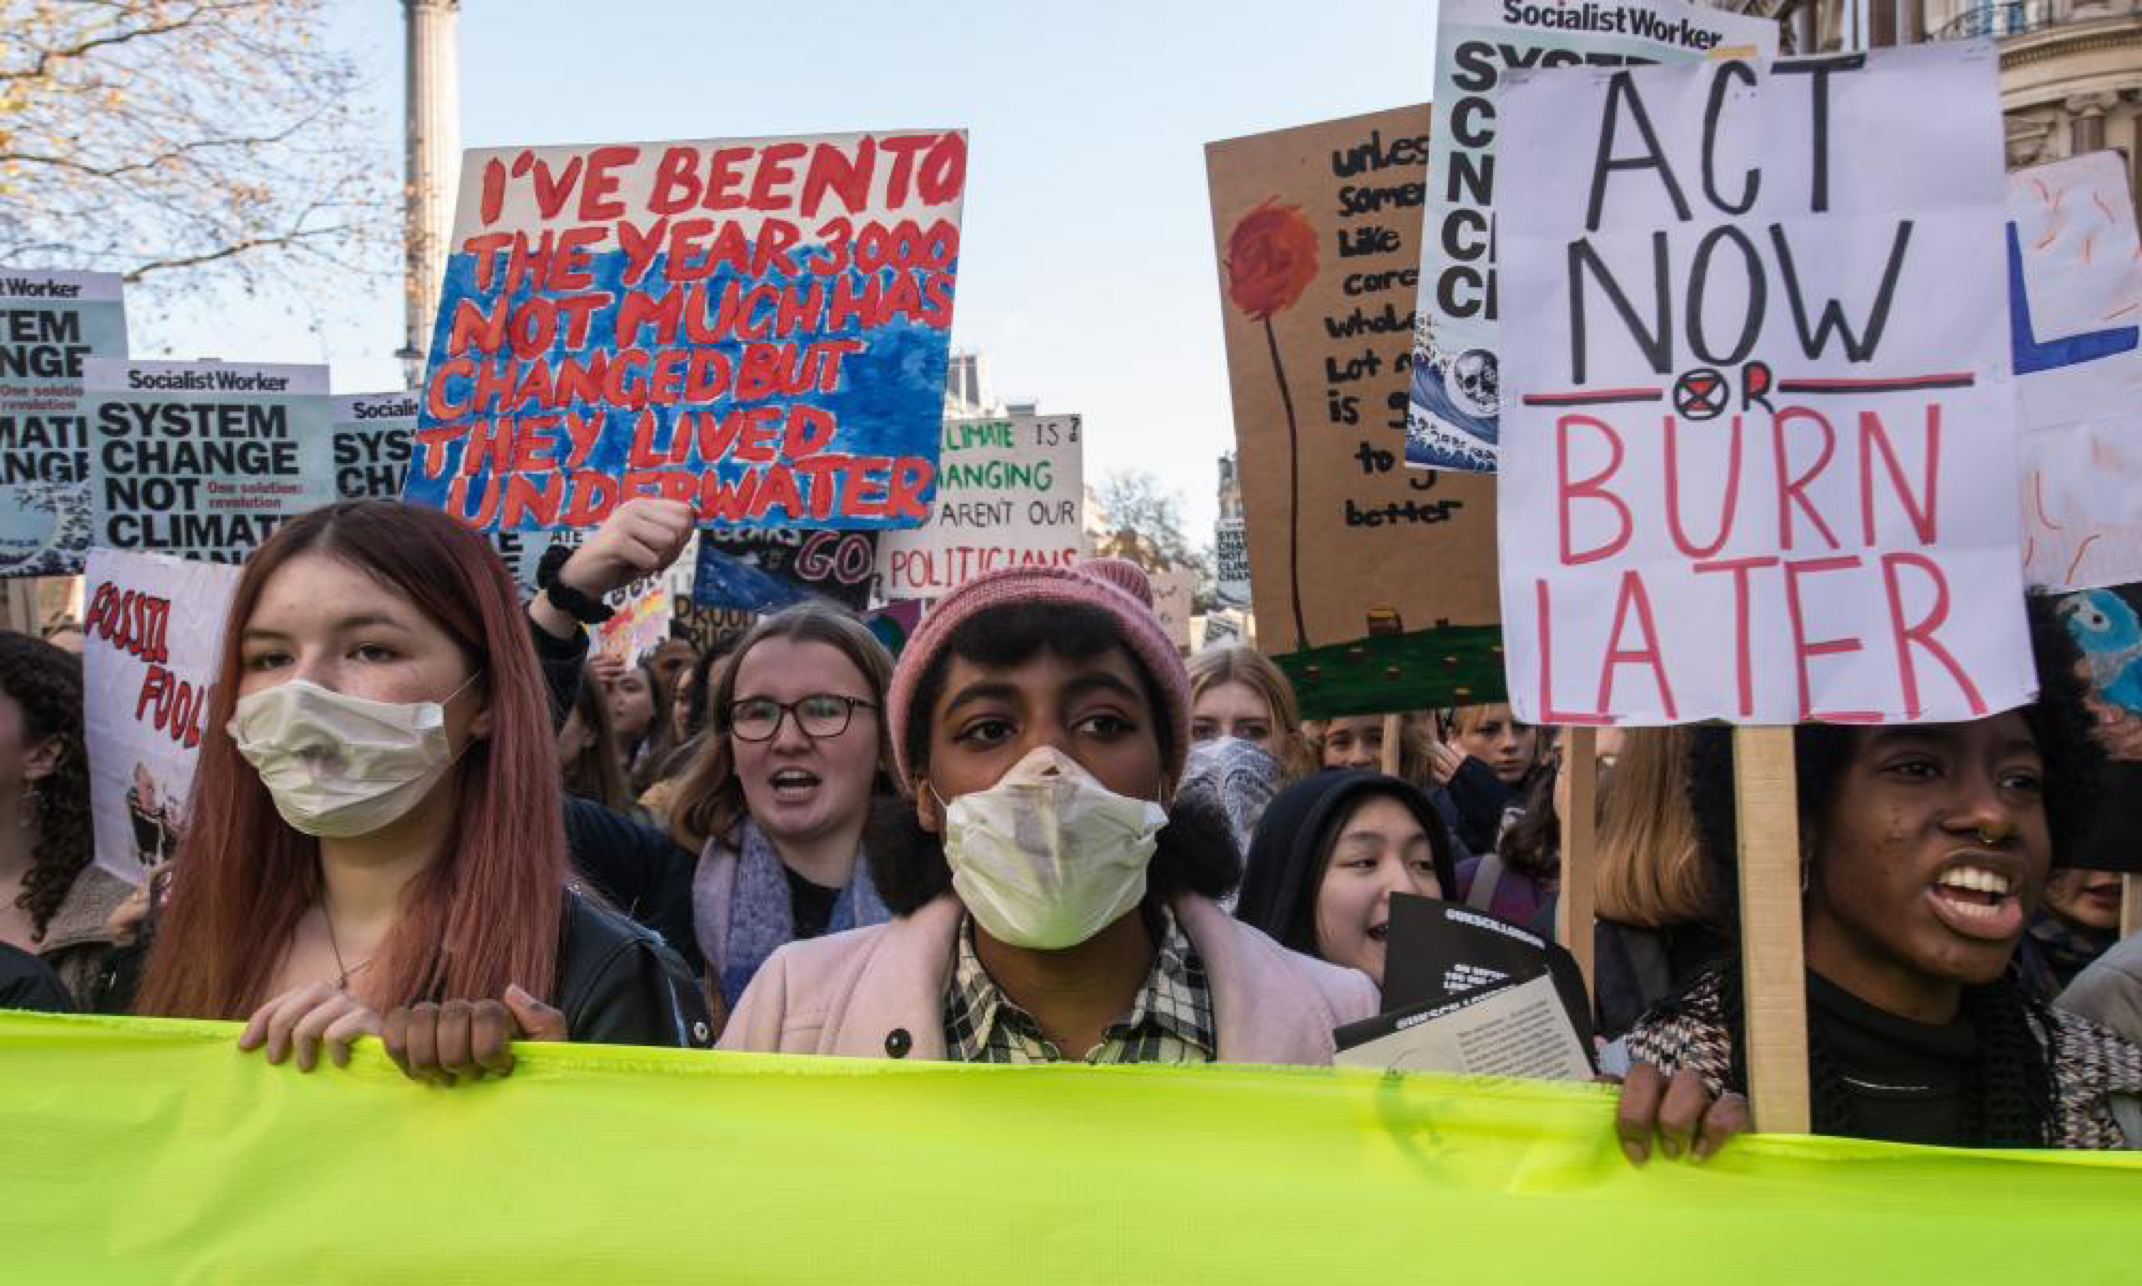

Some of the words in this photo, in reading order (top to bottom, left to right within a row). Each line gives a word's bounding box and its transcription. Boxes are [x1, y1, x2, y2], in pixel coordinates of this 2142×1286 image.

[1504, 0, 1626, 32] Socialist
[1628, 8, 1722, 50] Worker
[1331, 130, 1430, 177] unles
[1587, 54, 1866, 231] ACT
[482, 146, 640, 225] I'VE
[1337, 181, 1426, 217] some
[463, 225, 609, 294] THE
[617, 218, 801, 288] YEAR
[808, 216, 961, 276] 3000
[6, 278, 81, 297] Worker
[1568, 220, 1915, 384] NOW
[449, 292, 615, 362] NOT
[615, 278, 825, 350] MUCH
[827, 272, 956, 331] HAS
[0, 345, 92, 378] NGE
[34, 384, 84, 397] solutio
[128, 369, 214, 391] Socialist
[217, 372, 289, 392] Worker
[427, 347, 733, 423] CHANGED
[734, 340, 864, 399] BUT
[98, 402, 286, 439] SYSTEM
[1328, 389, 1358, 426] is
[333, 430, 415, 464] SYS
[416, 409, 606, 479] THEY
[628, 405, 836, 470] LIVED
[943, 421, 1014, 452] LIMATE
[101, 441, 299, 475] CHANGE
[1354, 441, 1395, 474] to
[937, 460, 1053, 492] ANGING
[1556, 403, 1941, 565] BURN
[105, 477, 200, 512] NOT
[207, 480, 235, 494] One
[207, 497, 281, 509] revolution
[940, 500, 1014, 527] ARENT
[1028, 501, 1075, 525] OUR
[1345, 499, 1464, 528] better
[795, 530, 873, 584] GO
[1536, 552, 1989, 724] LATER
